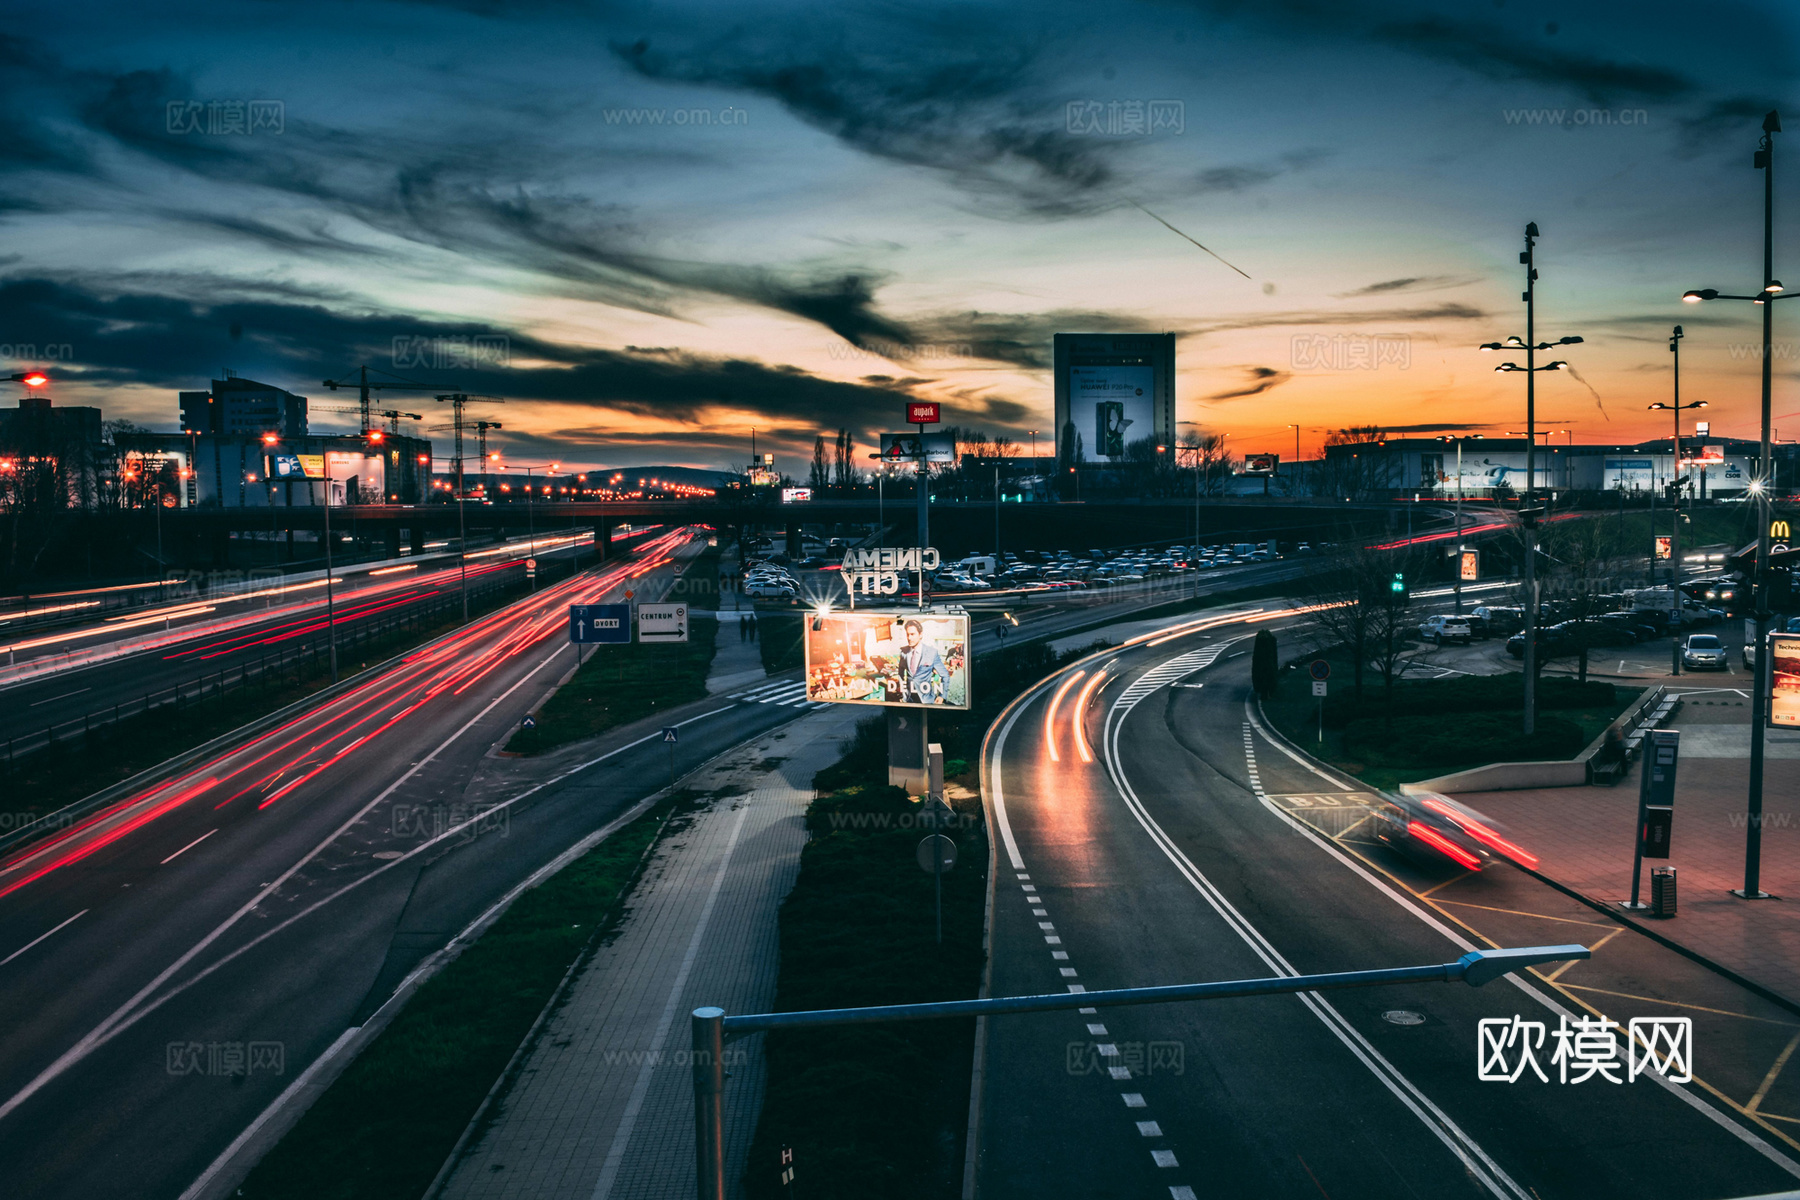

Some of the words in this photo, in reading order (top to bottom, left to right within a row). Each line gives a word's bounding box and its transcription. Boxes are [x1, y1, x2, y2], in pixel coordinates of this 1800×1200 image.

[913, 406, 934, 417] aupark
[1672, 610, 1678, 620] P
[826, 677, 879, 691] ALAIN
[887, 679, 944, 694] DELON
[1285, 795, 1370, 807] BUS
